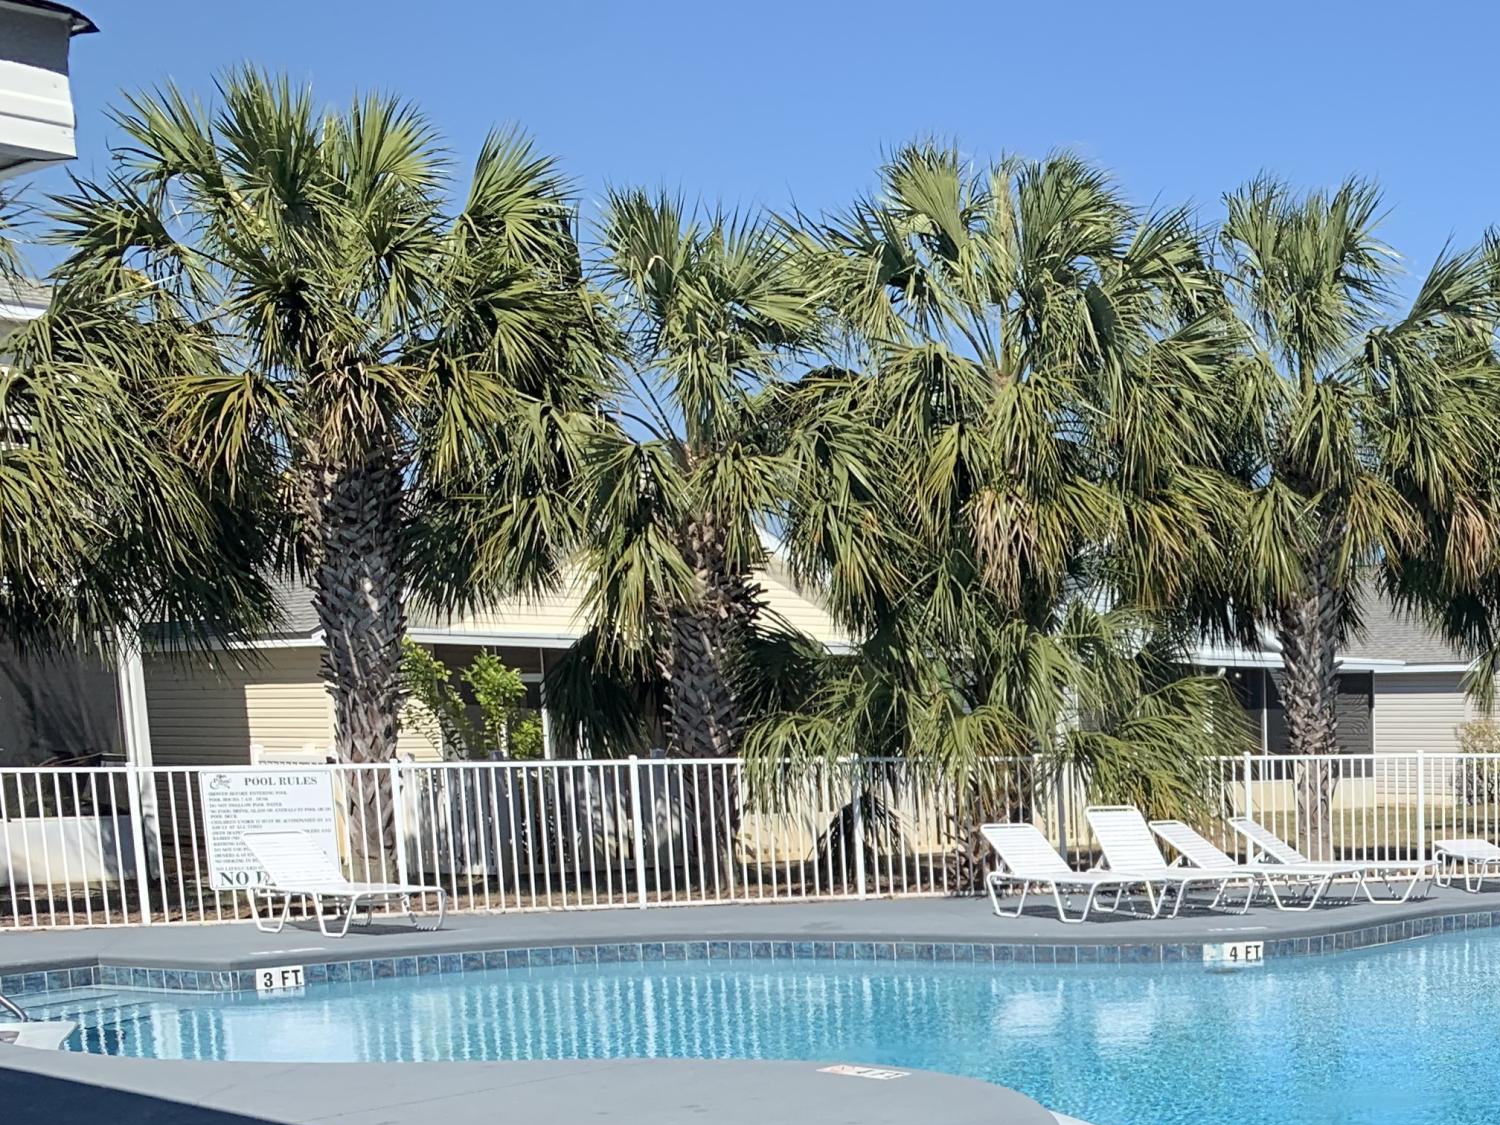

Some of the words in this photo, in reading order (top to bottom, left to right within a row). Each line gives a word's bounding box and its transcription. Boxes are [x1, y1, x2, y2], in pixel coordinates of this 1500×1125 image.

[244, 777, 276, 786] POOL
[279, 776, 318, 786] RULES
[219, 871, 249, 886] NO
[1229, 946, 1238, 961] 4
[263, 972, 273, 988] 3
